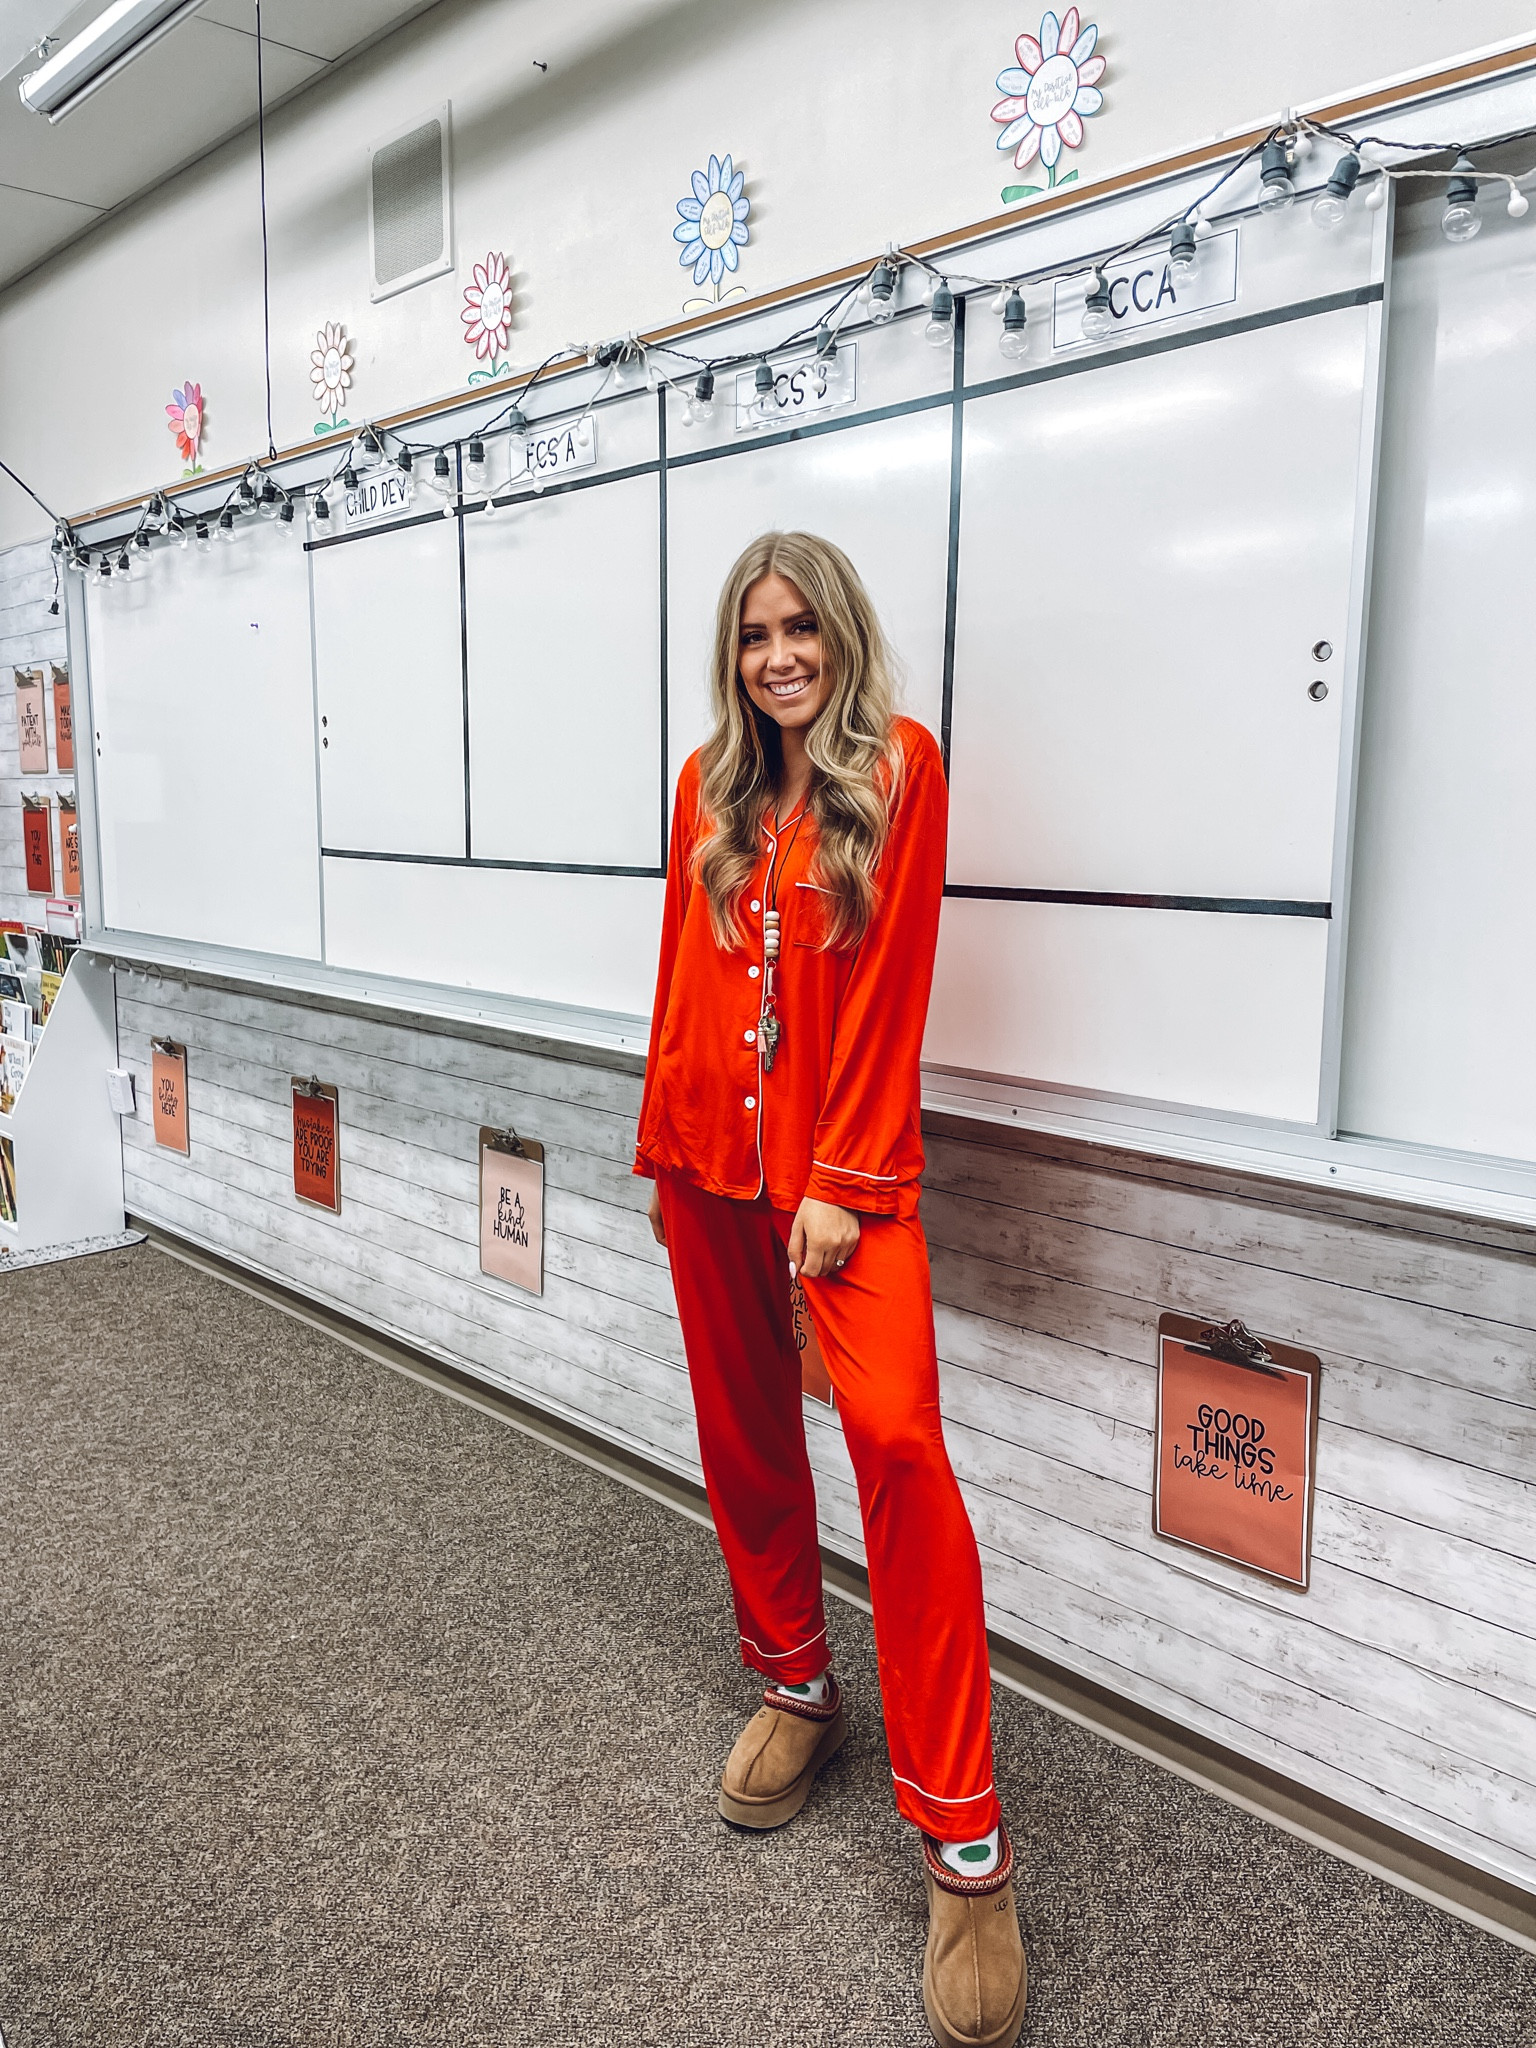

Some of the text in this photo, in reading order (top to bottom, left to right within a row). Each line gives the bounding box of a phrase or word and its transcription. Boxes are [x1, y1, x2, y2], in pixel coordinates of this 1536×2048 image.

[1109, 264, 1176, 319] CCA
[526, 431, 576, 472] FCS A
[346, 478, 406, 516] CHILD DEV
[158, 1087, 178, 1110] belong
[161, 1077, 175, 1093] YOU
[161, 1101, 176, 1118] HERE
[295, 1127, 333, 1152] ARE PROOF
[298, 1141, 330, 1167] YOU ARE
[300, 1156, 327, 1179] TRYING
[500, 1187, 521, 1208] BE A
[498, 1201, 525, 1230] kind
[493, 1219, 529, 1248] HUMAN
[1197, 1403, 1265, 1444] GOOD
[1186, 1423, 1276, 1475] THINGS
[1173, 1443, 1294, 1503] take time
